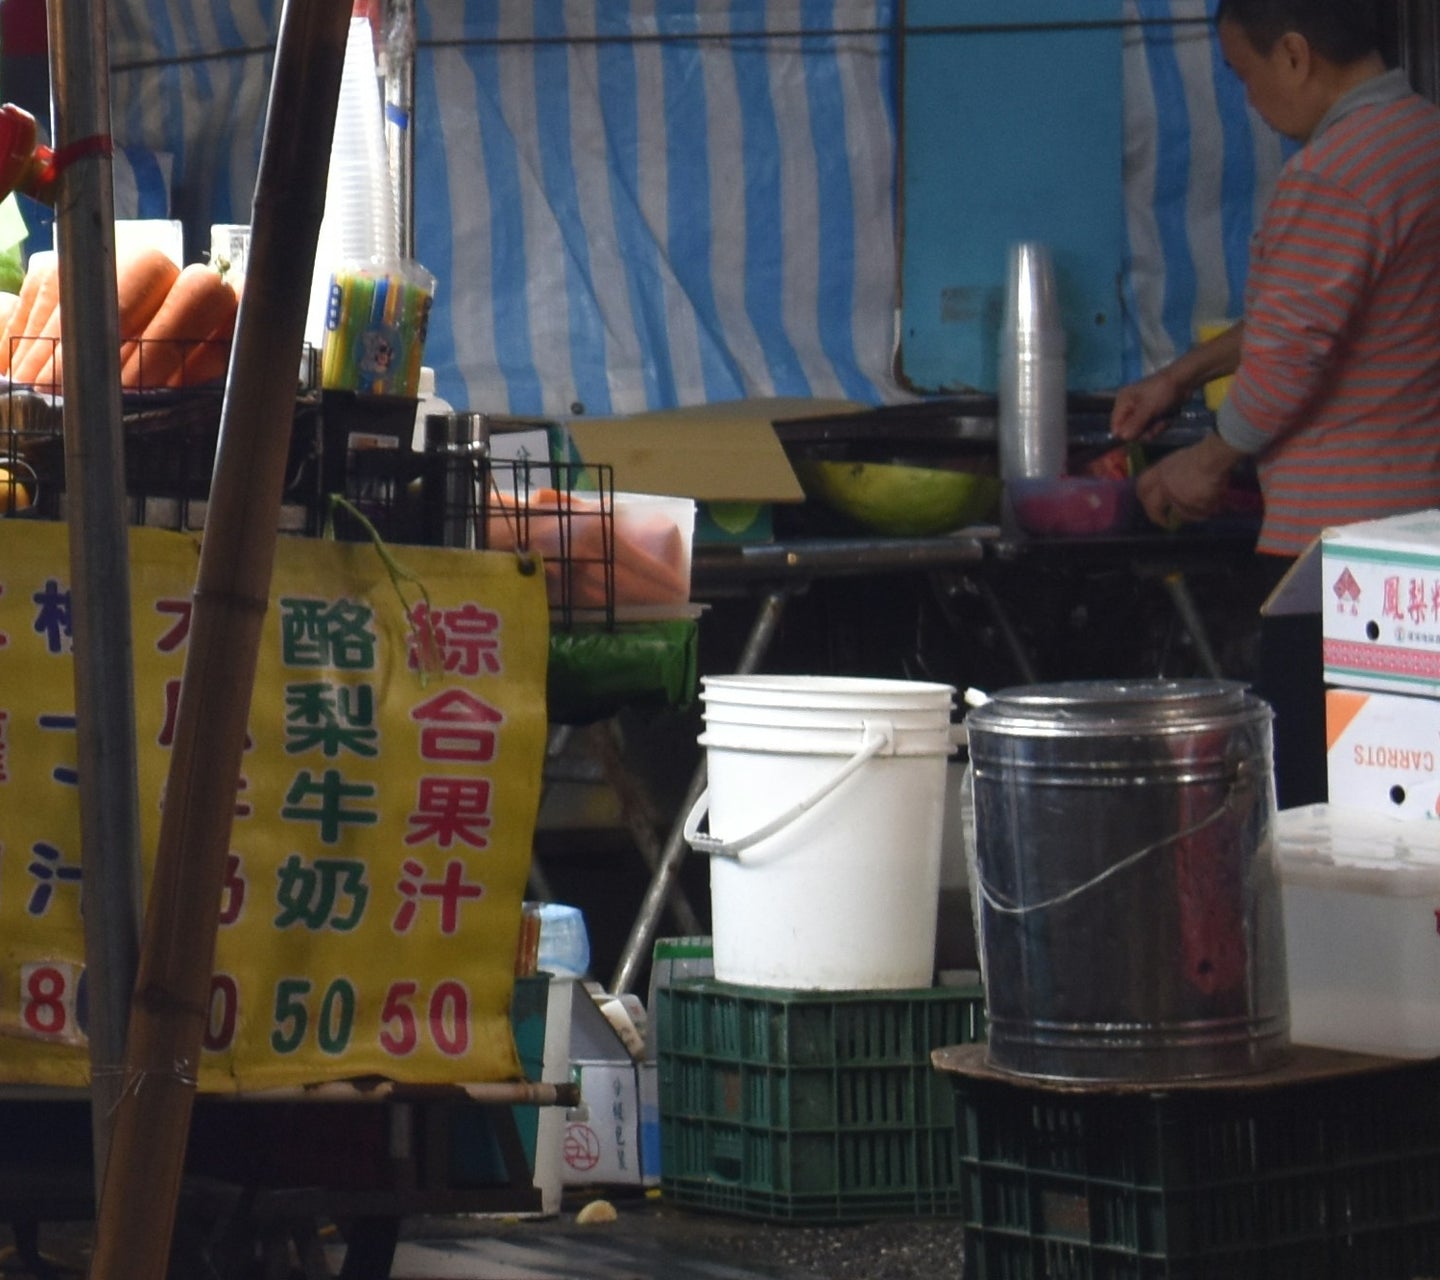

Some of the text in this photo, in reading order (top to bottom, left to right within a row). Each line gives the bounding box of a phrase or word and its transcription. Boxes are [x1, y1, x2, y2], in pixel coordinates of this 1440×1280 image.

[273, 596, 379, 932] 酪梨牛奶
[393, 601, 504, 934] 綜合果汁
[1353, 743, 1434, 772] CARROTS
[24, 962, 86, 1036] 8
[271, 978, 355, 1056] 50
[379, 979, 470, 1057] 50
